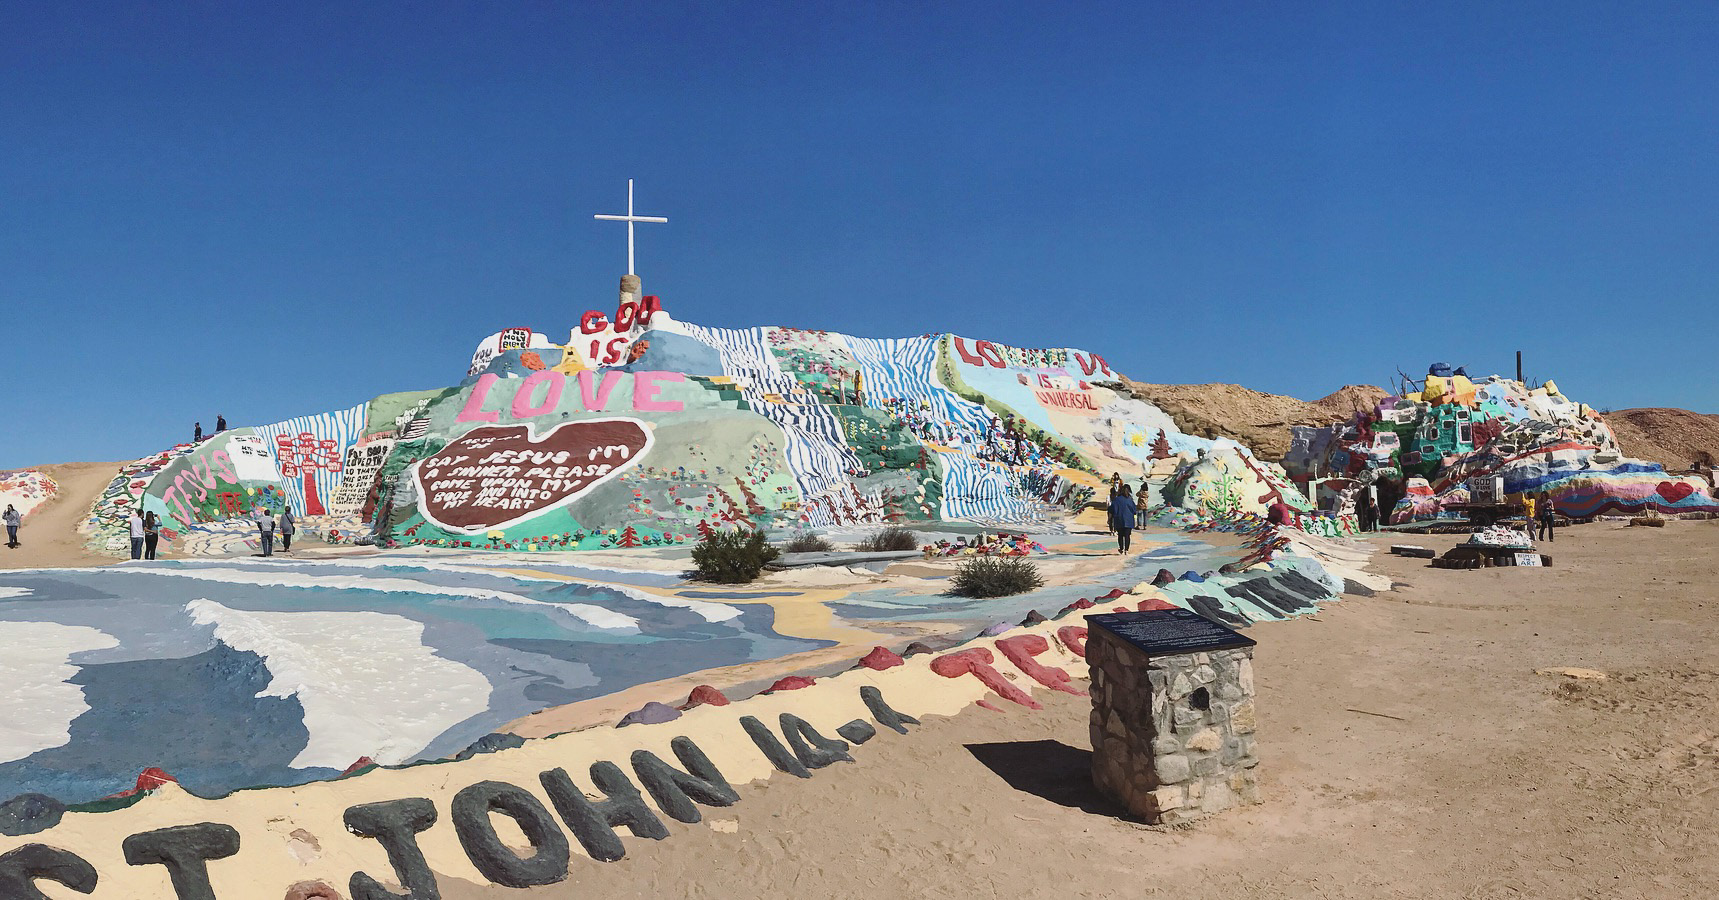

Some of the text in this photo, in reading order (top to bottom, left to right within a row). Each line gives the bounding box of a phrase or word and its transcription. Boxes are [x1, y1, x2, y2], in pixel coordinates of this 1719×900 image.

[580, 295, 663, 335] GOD
[590, 337, 629, 364] IS
[1036, 374, 1051, 389] IS
[455, 370, 685, 423] LOVE
[1034, 390, 1098, 411] UNIVERSAL
[426, 455, 469, 468] SAY
[478, 449, 570, 465] JESUS
[424, 464, 612, 480] A SINNER PLEASE
[163, 449, 238, 526] JESUS
[430, 477, 583, 492] COME UPON MY
[1474, 478, 1491, 486] GOD
[475, 487, 504, 499] AND
[510, 487, 551, 500] INTO
[442, 498, 535, 510] MY HEART
[343, 736, 741, 900] JOHN
